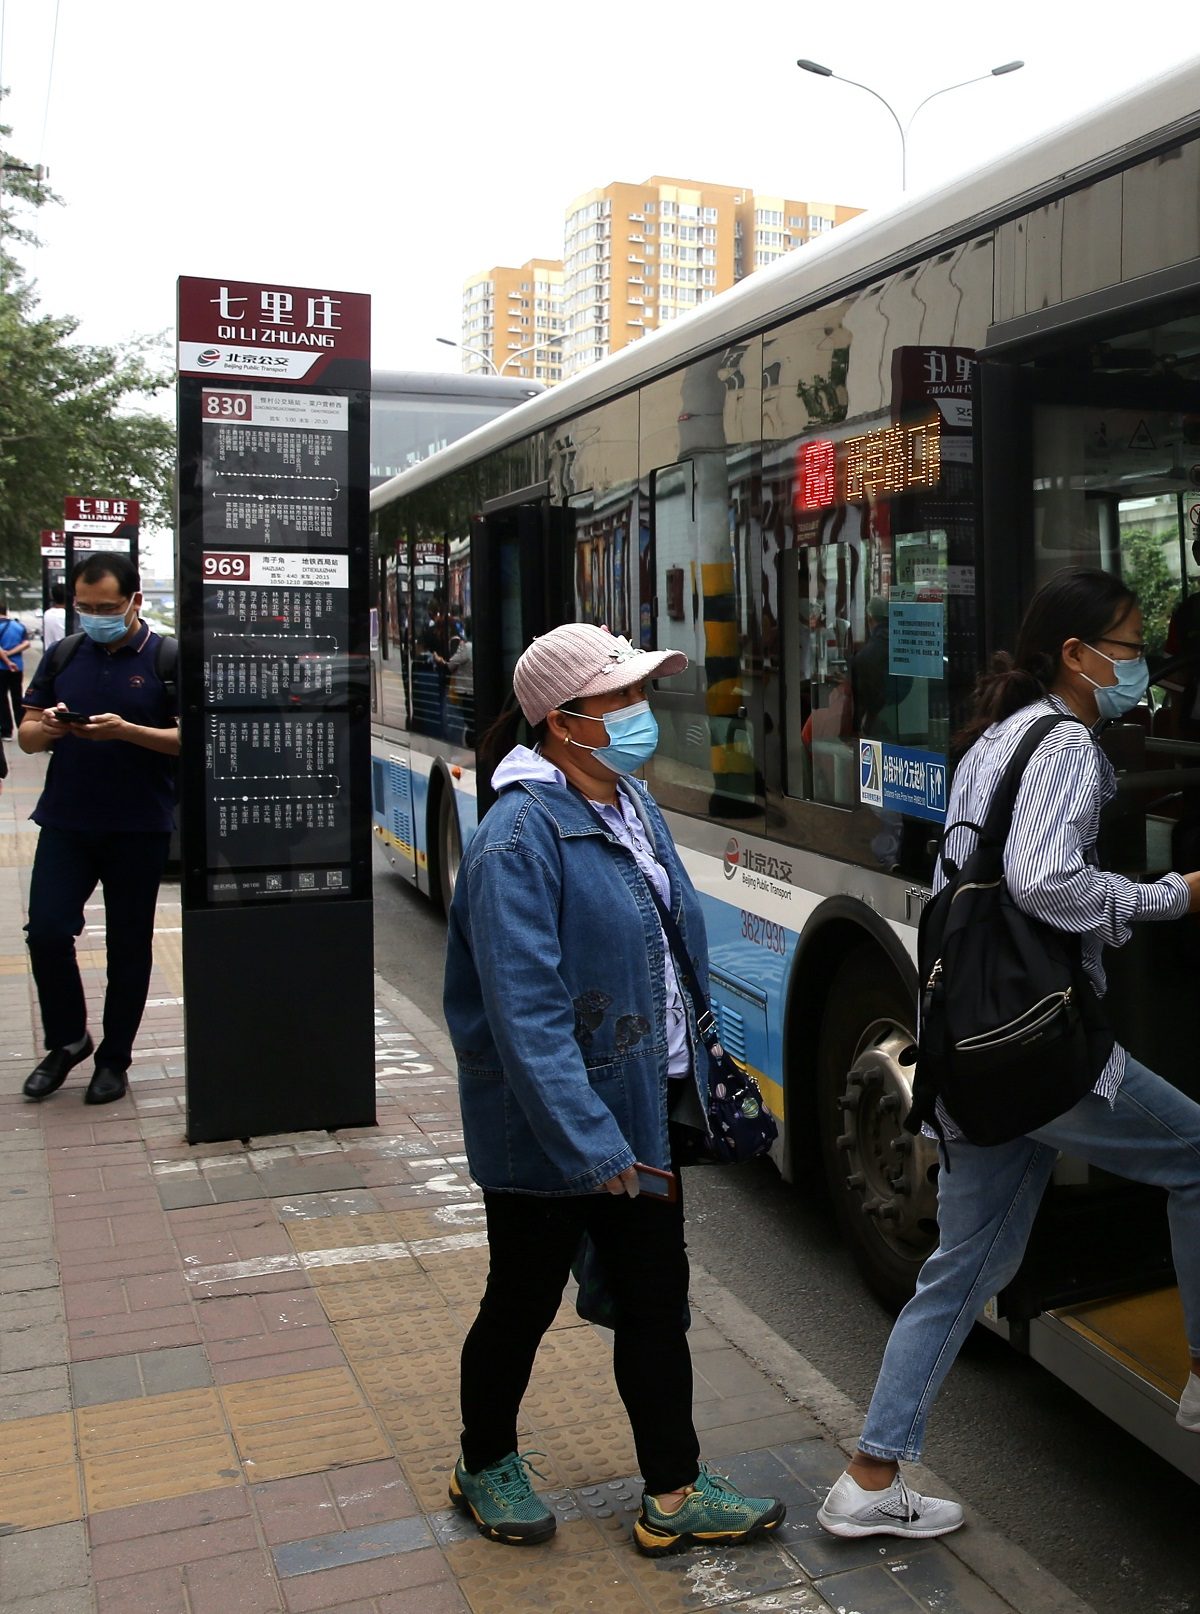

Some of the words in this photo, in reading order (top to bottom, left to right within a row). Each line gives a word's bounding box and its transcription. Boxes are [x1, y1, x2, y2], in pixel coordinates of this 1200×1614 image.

[210, 286, 342, 330] 七里庄
[218, 325, 235, 340] QI
[241, 327, 256, 341] LI
[261, 329, 335, 348] ZHUANG
[224, 363, 242, 371] Beijing
[261, 365, 287, 373] Transport
[226, 353, 289, 367] 北京公交
[207, 396, 247, 416] 830
[77, 499, 128, 515] 七里庄
[205, 558, 245, 576] 969
[262, 556, 285, 564] 海子角
[884, 755, 925, 792] 分段计价2元起价
[742, 849, 793, 883] 北京公交
[742, 873, 756, 890] Beijing
[757, 877, 769, 892] Public
[770, 882, 792, 900] Transport
[741, 909, 786, 956] 3627930
